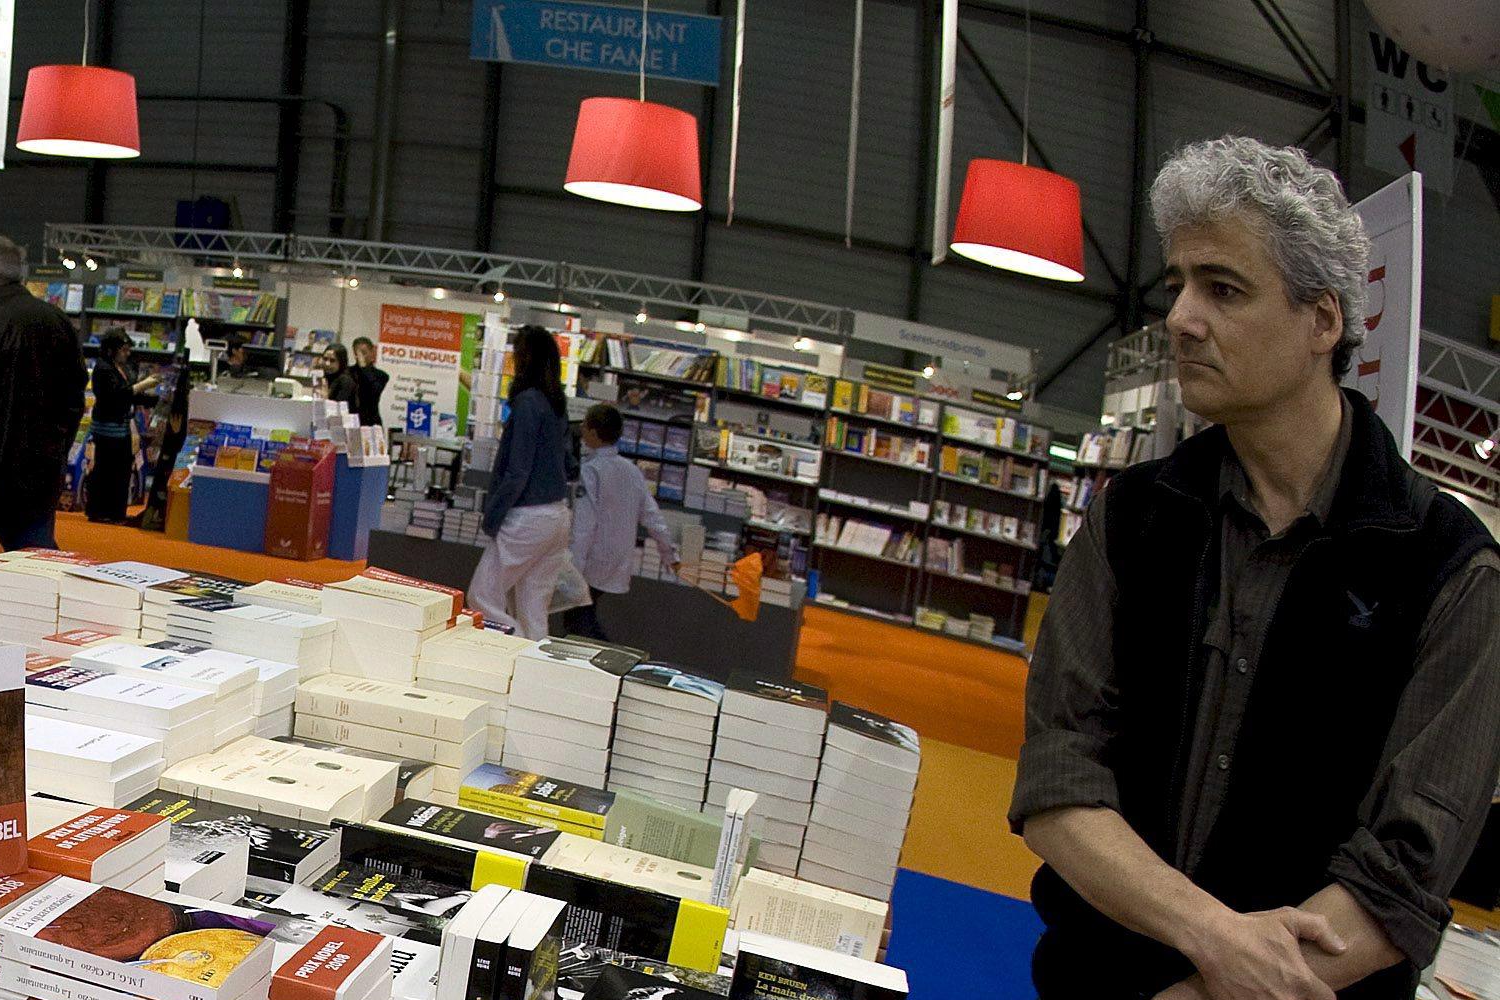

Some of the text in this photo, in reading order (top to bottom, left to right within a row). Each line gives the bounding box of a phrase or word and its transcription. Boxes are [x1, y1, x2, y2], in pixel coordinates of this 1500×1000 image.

[539, 9, 687, 43] RESTAURANT
[545, 37, 679, 72] CHE FAME !
[1369, 33, 1449, 93] WC
[381, 346, 406, 358] PRO
[409, 350, 458, 364] LINGUIS
[44, 815, 105, 840] PRIX NOBEL
[56, 839, 79, 850] DE
[295, 940, 345, 980] PRIX NOBEL
[324, 952, 350, 974] 2008
[755, 980, 769, 993] La
[771, 984, 798, 999] main
[757, 971, 808, 991] KEN BRUEN
